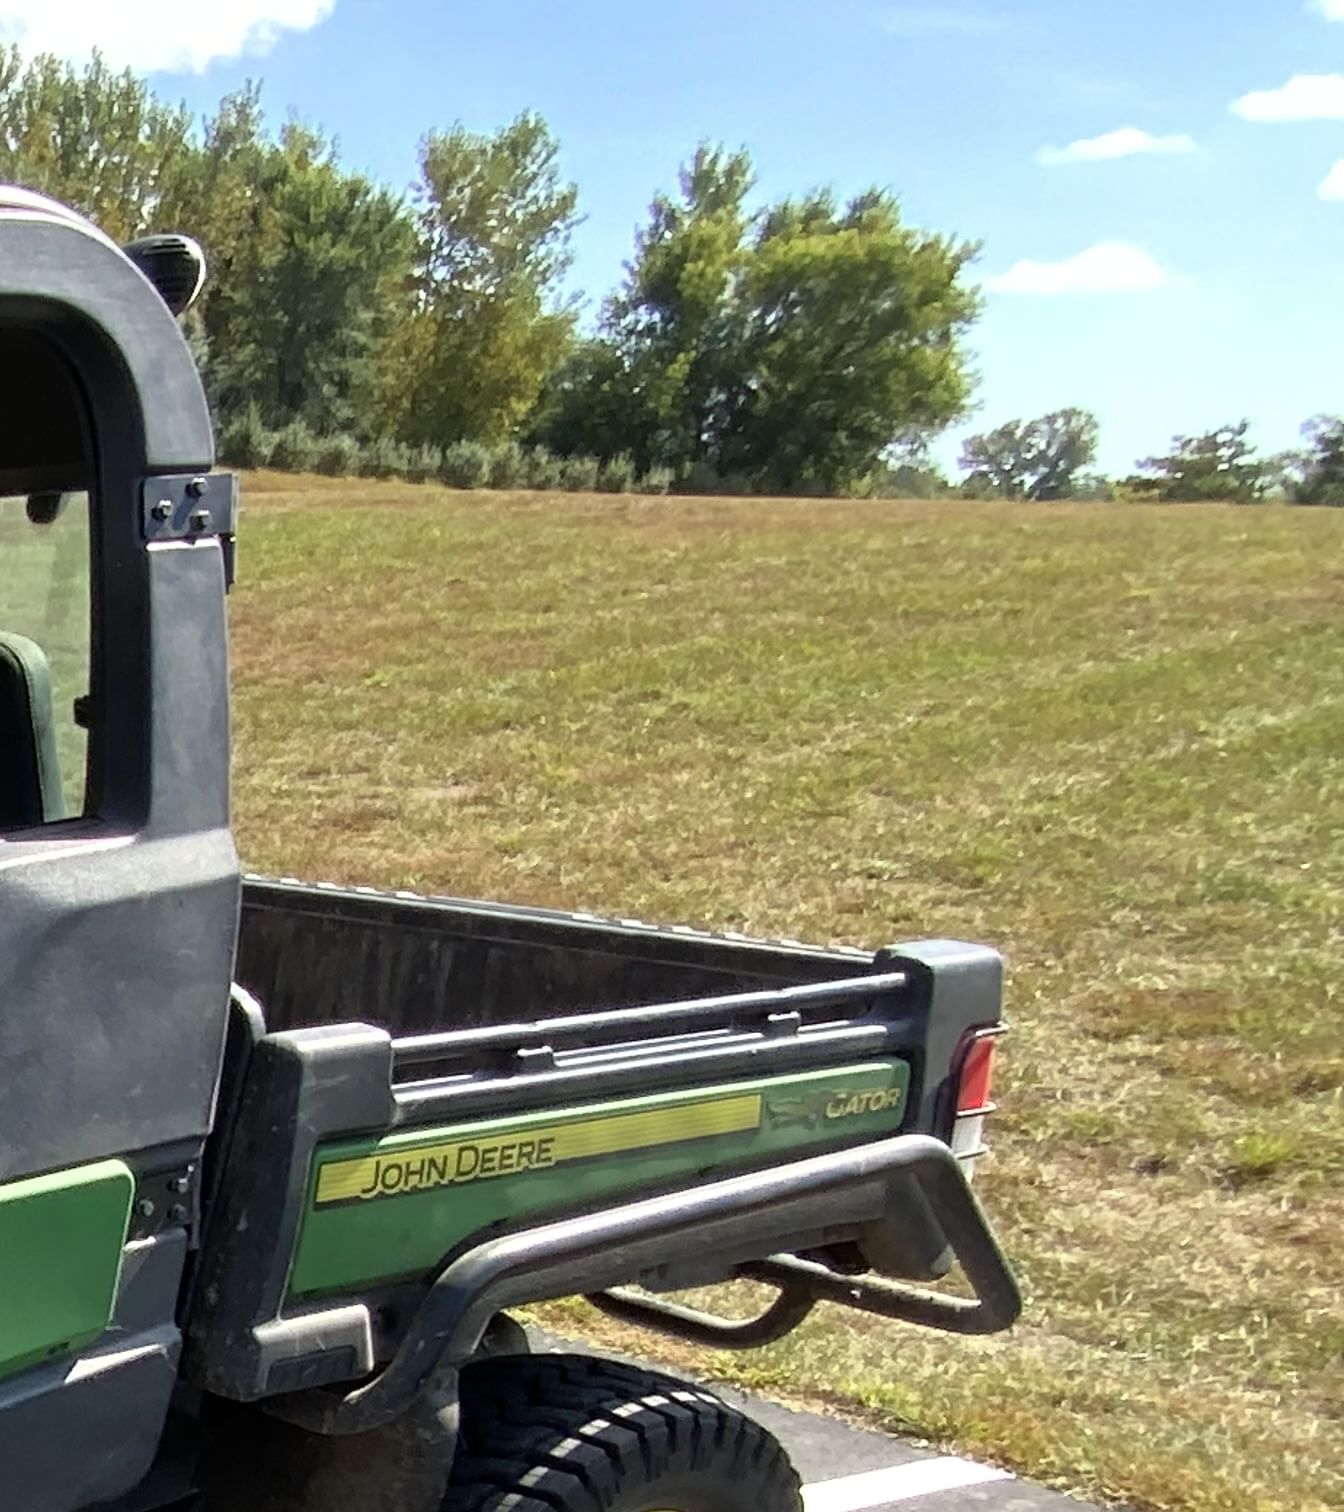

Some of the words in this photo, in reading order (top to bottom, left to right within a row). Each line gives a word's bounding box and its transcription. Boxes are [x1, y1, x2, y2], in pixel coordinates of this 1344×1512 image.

[825, 1087, 901, 1119] GATOR
[360, 1154, 449, 1195] JOHN
[455, 1136, 556, 1178] DEERE
